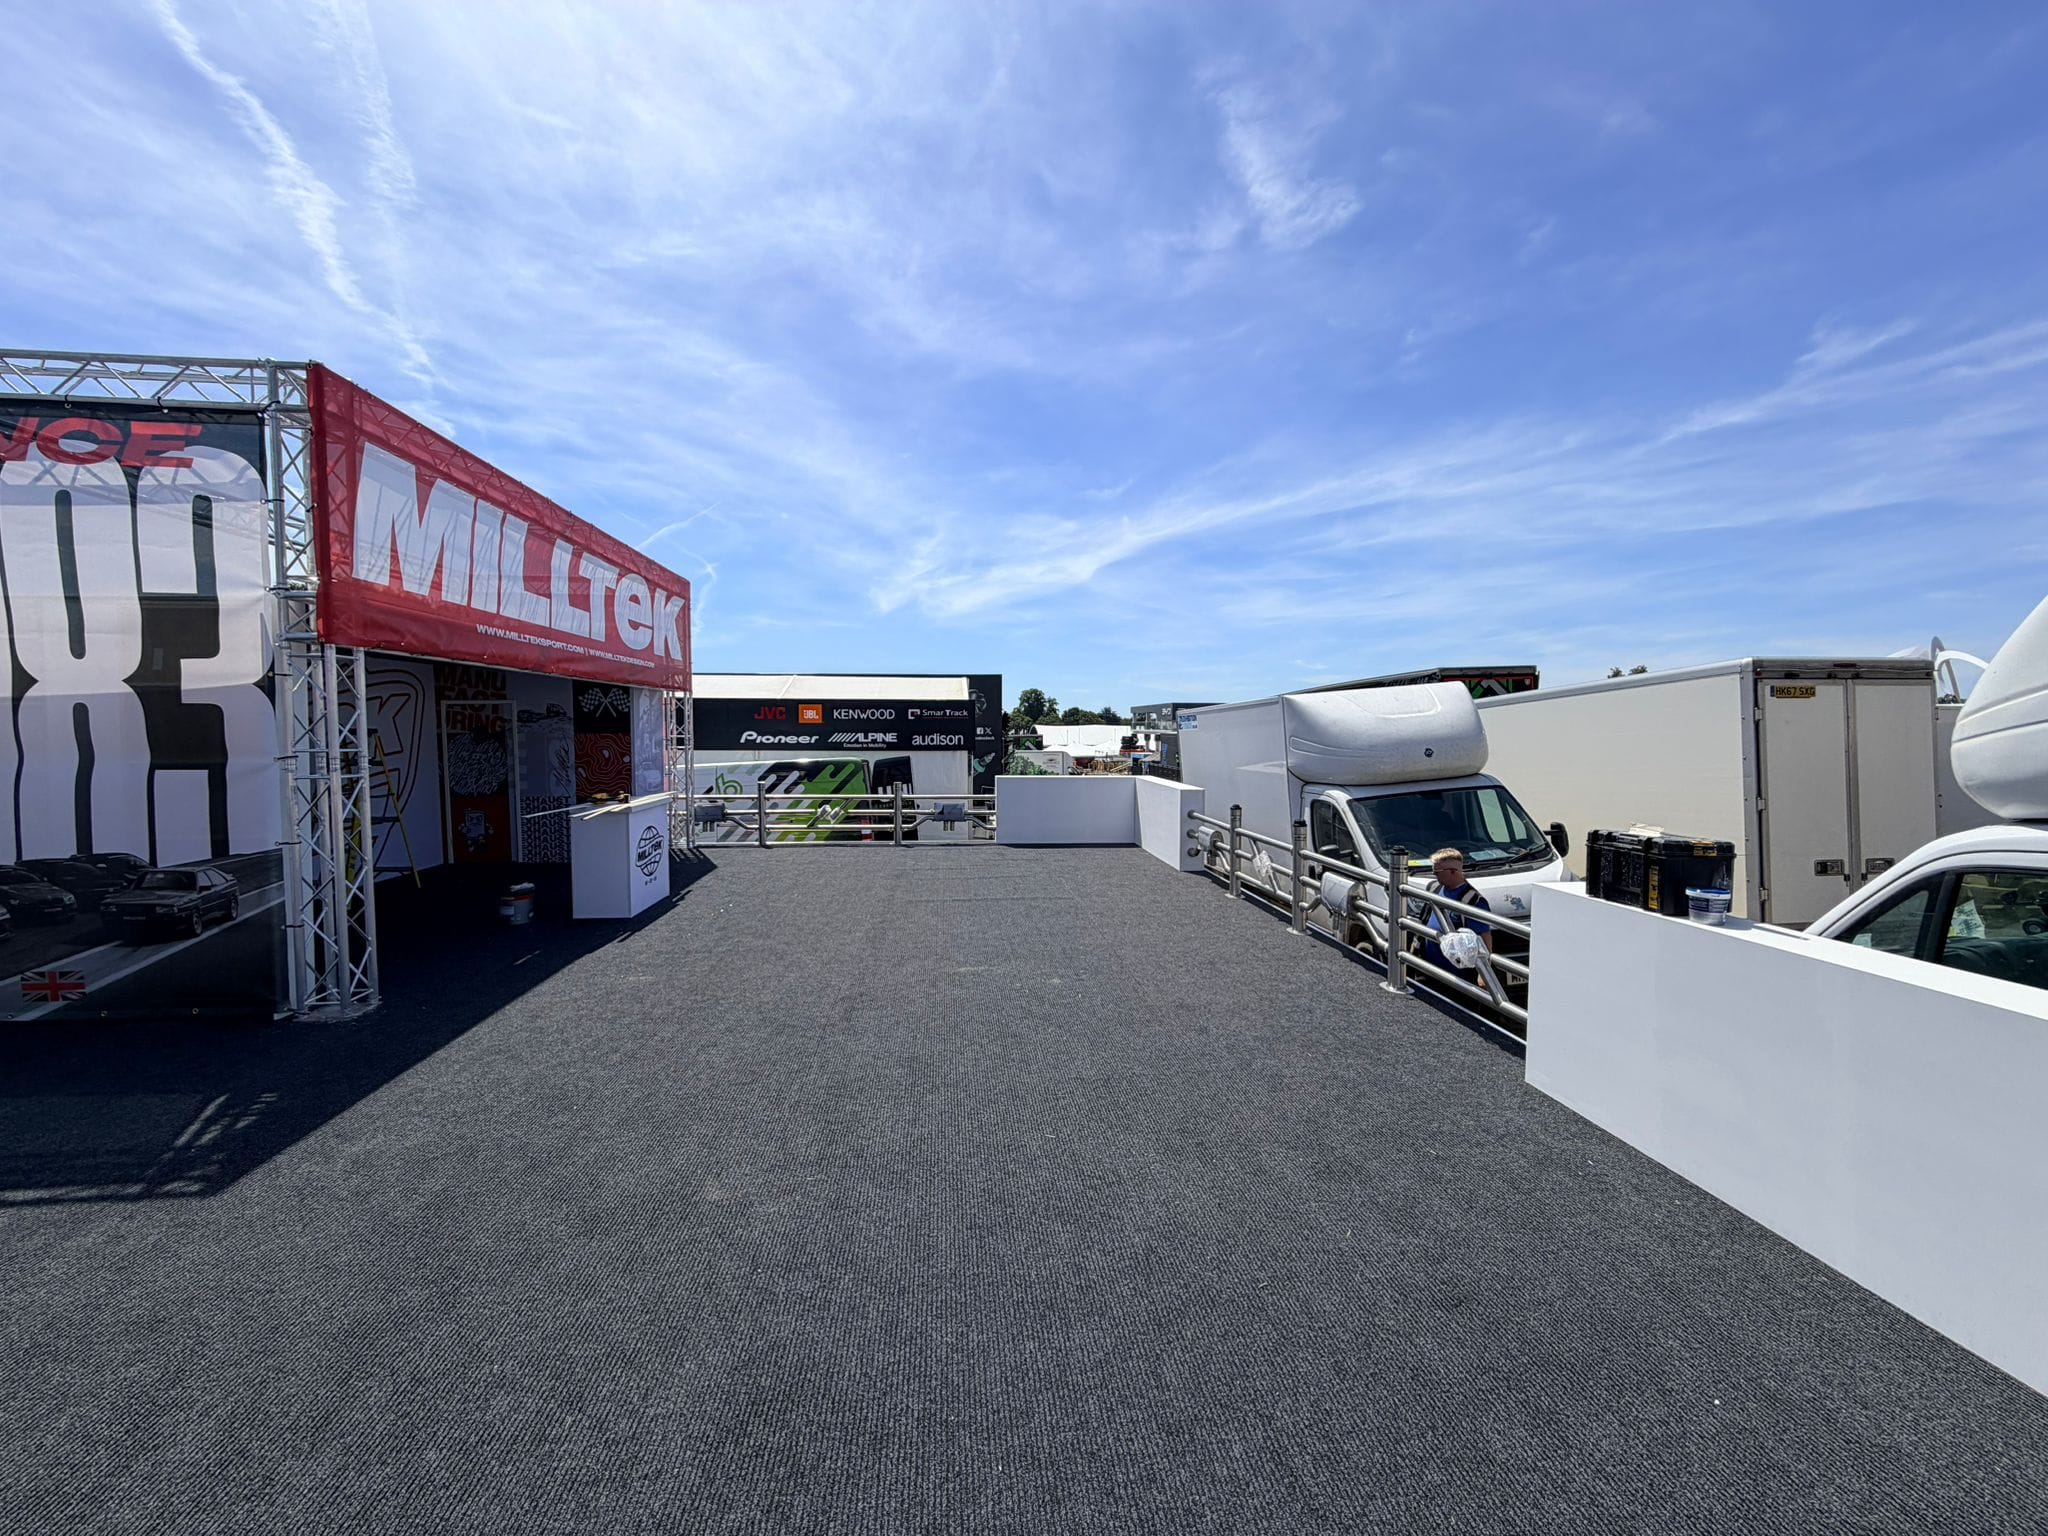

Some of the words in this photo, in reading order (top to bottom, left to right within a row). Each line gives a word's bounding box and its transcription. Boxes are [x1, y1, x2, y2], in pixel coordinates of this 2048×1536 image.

[476, 623, 585, 656] WWW.MILLTEKSPORT.COM
[0, 443, 285, 867] 83
[753, 706, 787, 720] JVC
[803, 709, 819, 719] JBL
[833, 708, 896, 720] KENWOOD
[739, 730, 819, 744] Pioneer
[911, 732, 964, 746] audison
